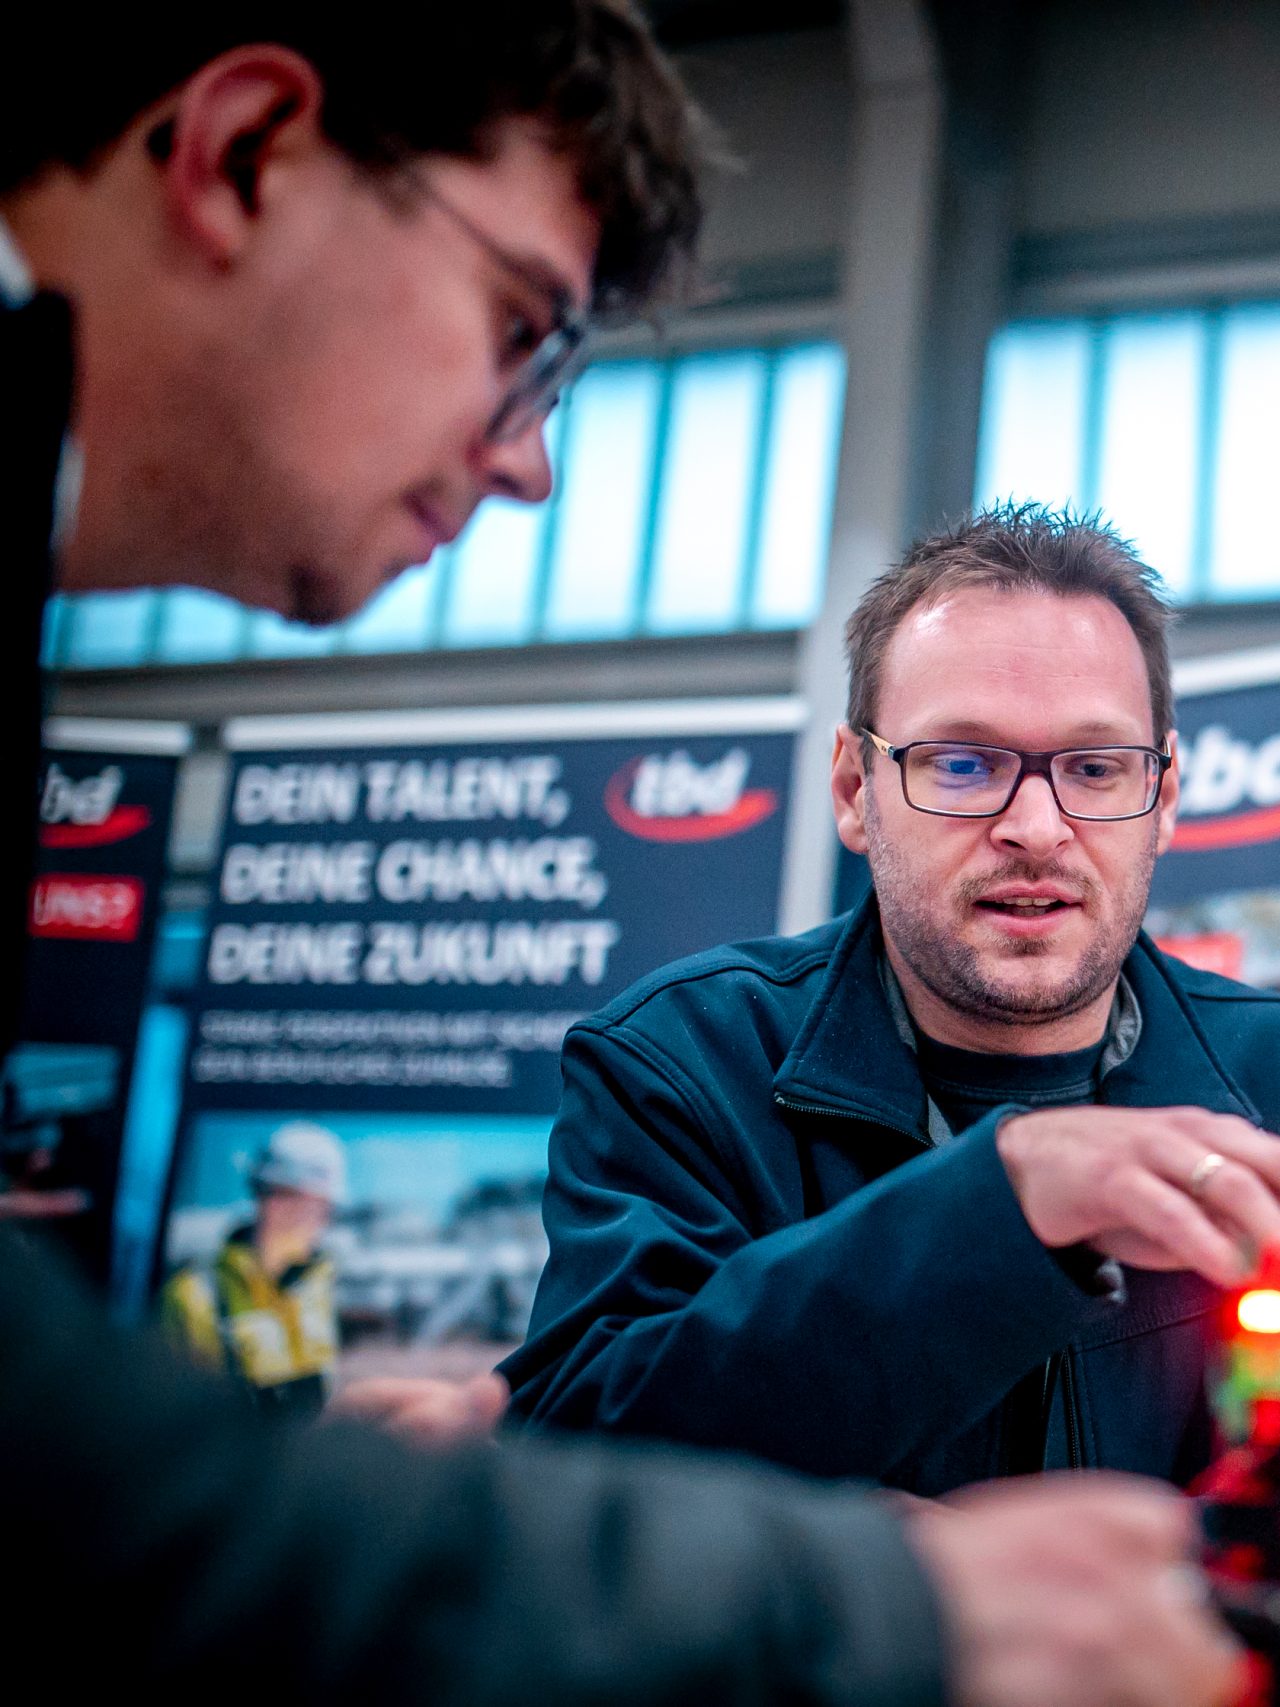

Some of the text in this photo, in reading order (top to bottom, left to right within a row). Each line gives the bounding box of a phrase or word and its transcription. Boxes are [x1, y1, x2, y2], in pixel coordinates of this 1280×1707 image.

[40, 762, 122, 826] bd
[235, 757, 570, 829] DEIN TALENT,
[632, 750, 750, 817] tbd
[220, 838, 607, 910] DEINE CHANCE,
[208, 919, 620, 985] DEINE ZUKUNFT
